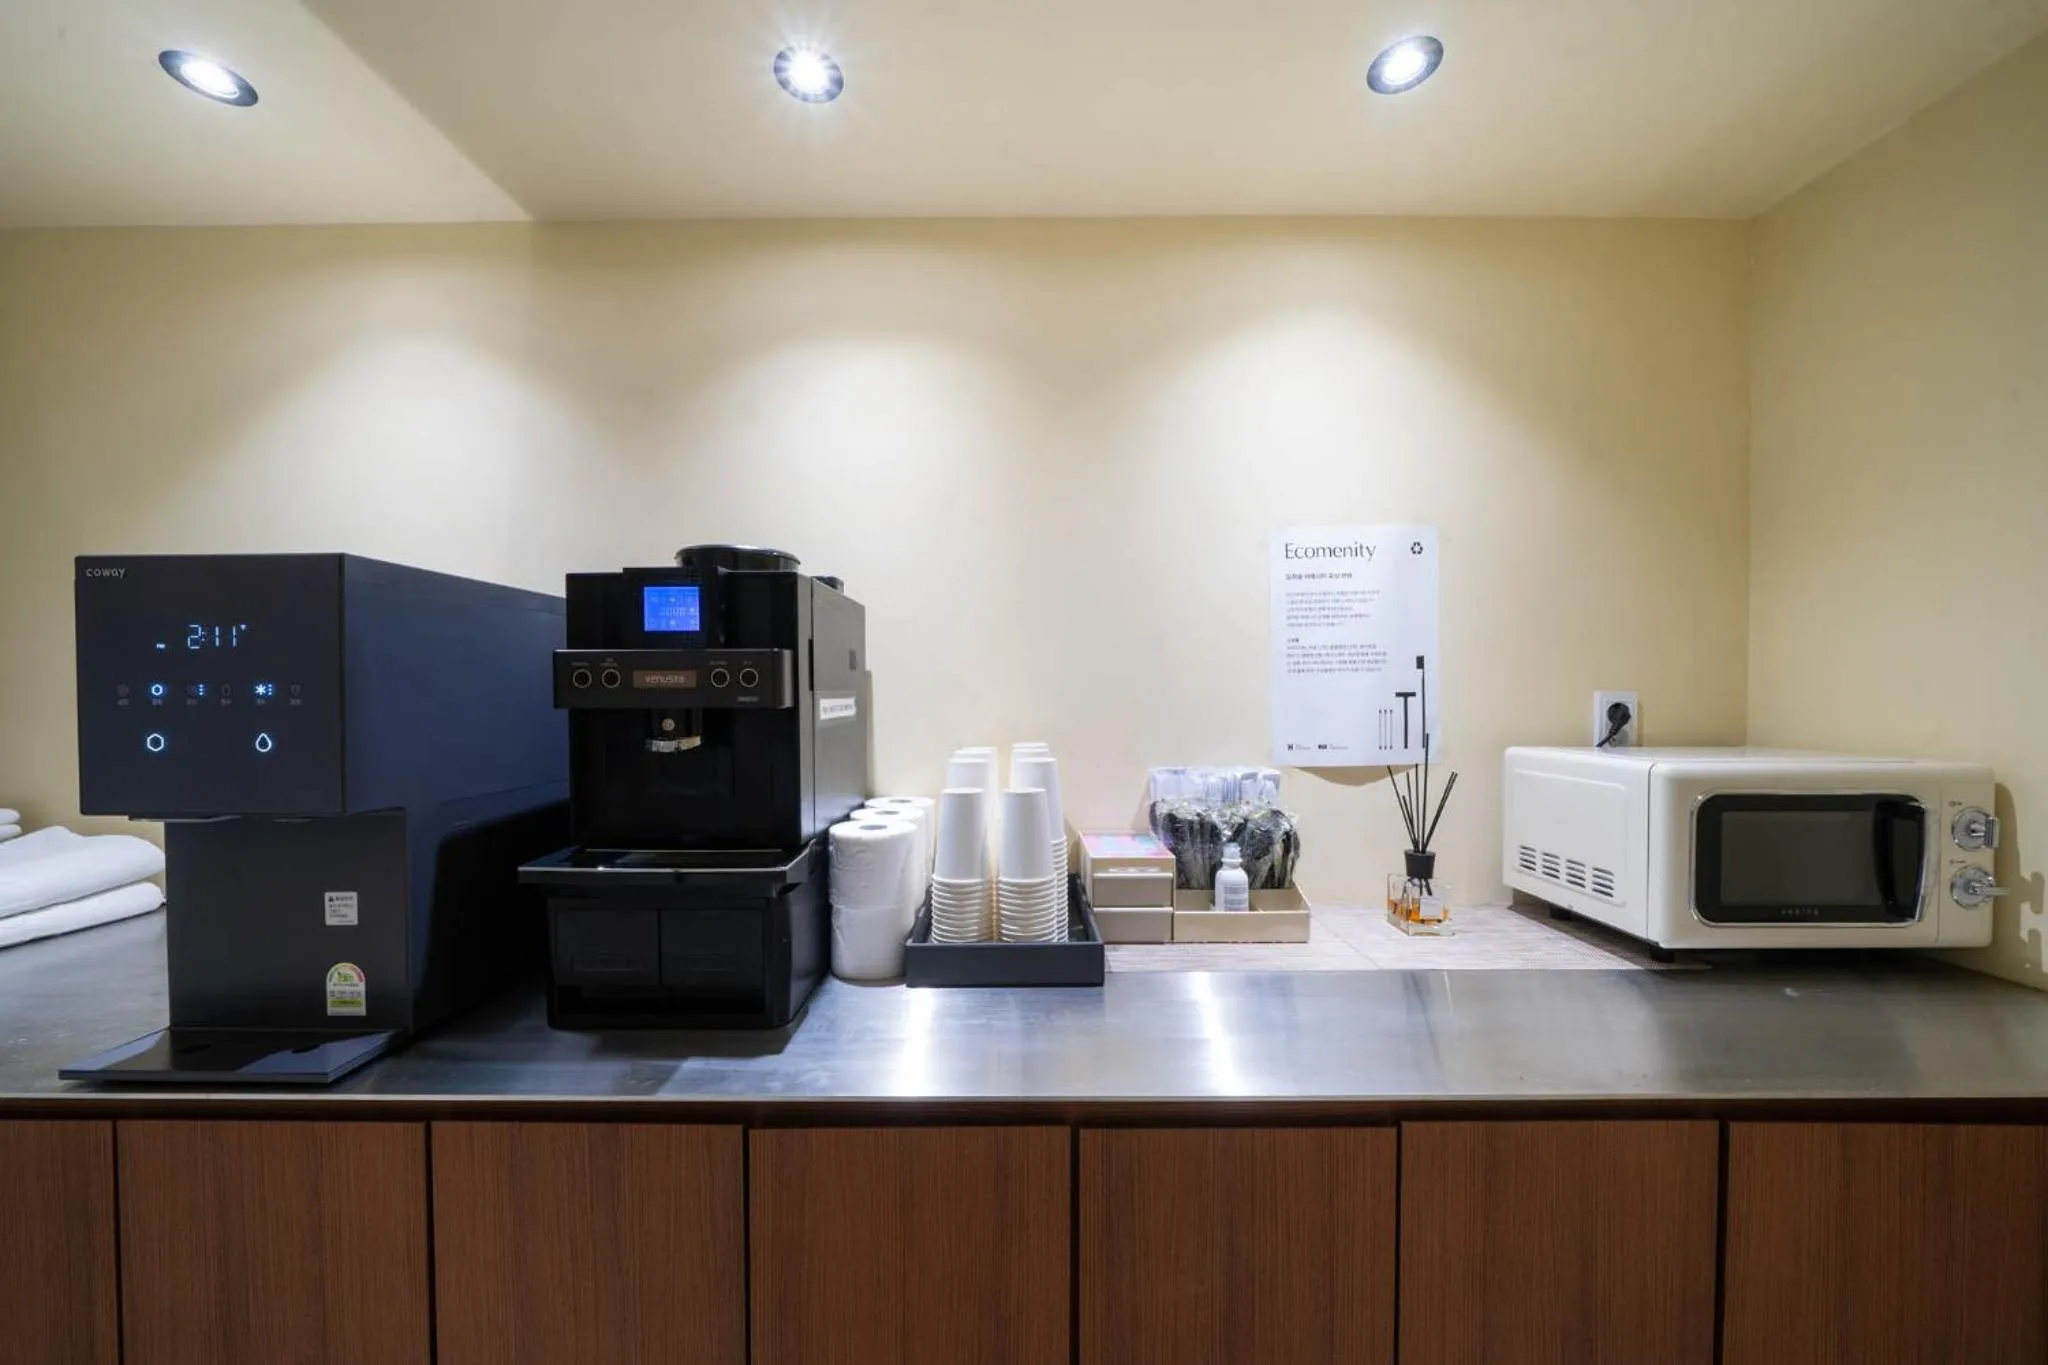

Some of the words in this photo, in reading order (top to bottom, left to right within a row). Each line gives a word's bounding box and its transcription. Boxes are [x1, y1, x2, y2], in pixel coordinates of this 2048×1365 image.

[1285, 540, 1376, 562] Ecomenity
[86, 568, 126, 579] coway
[187, 624, 237, 649] 2:11
